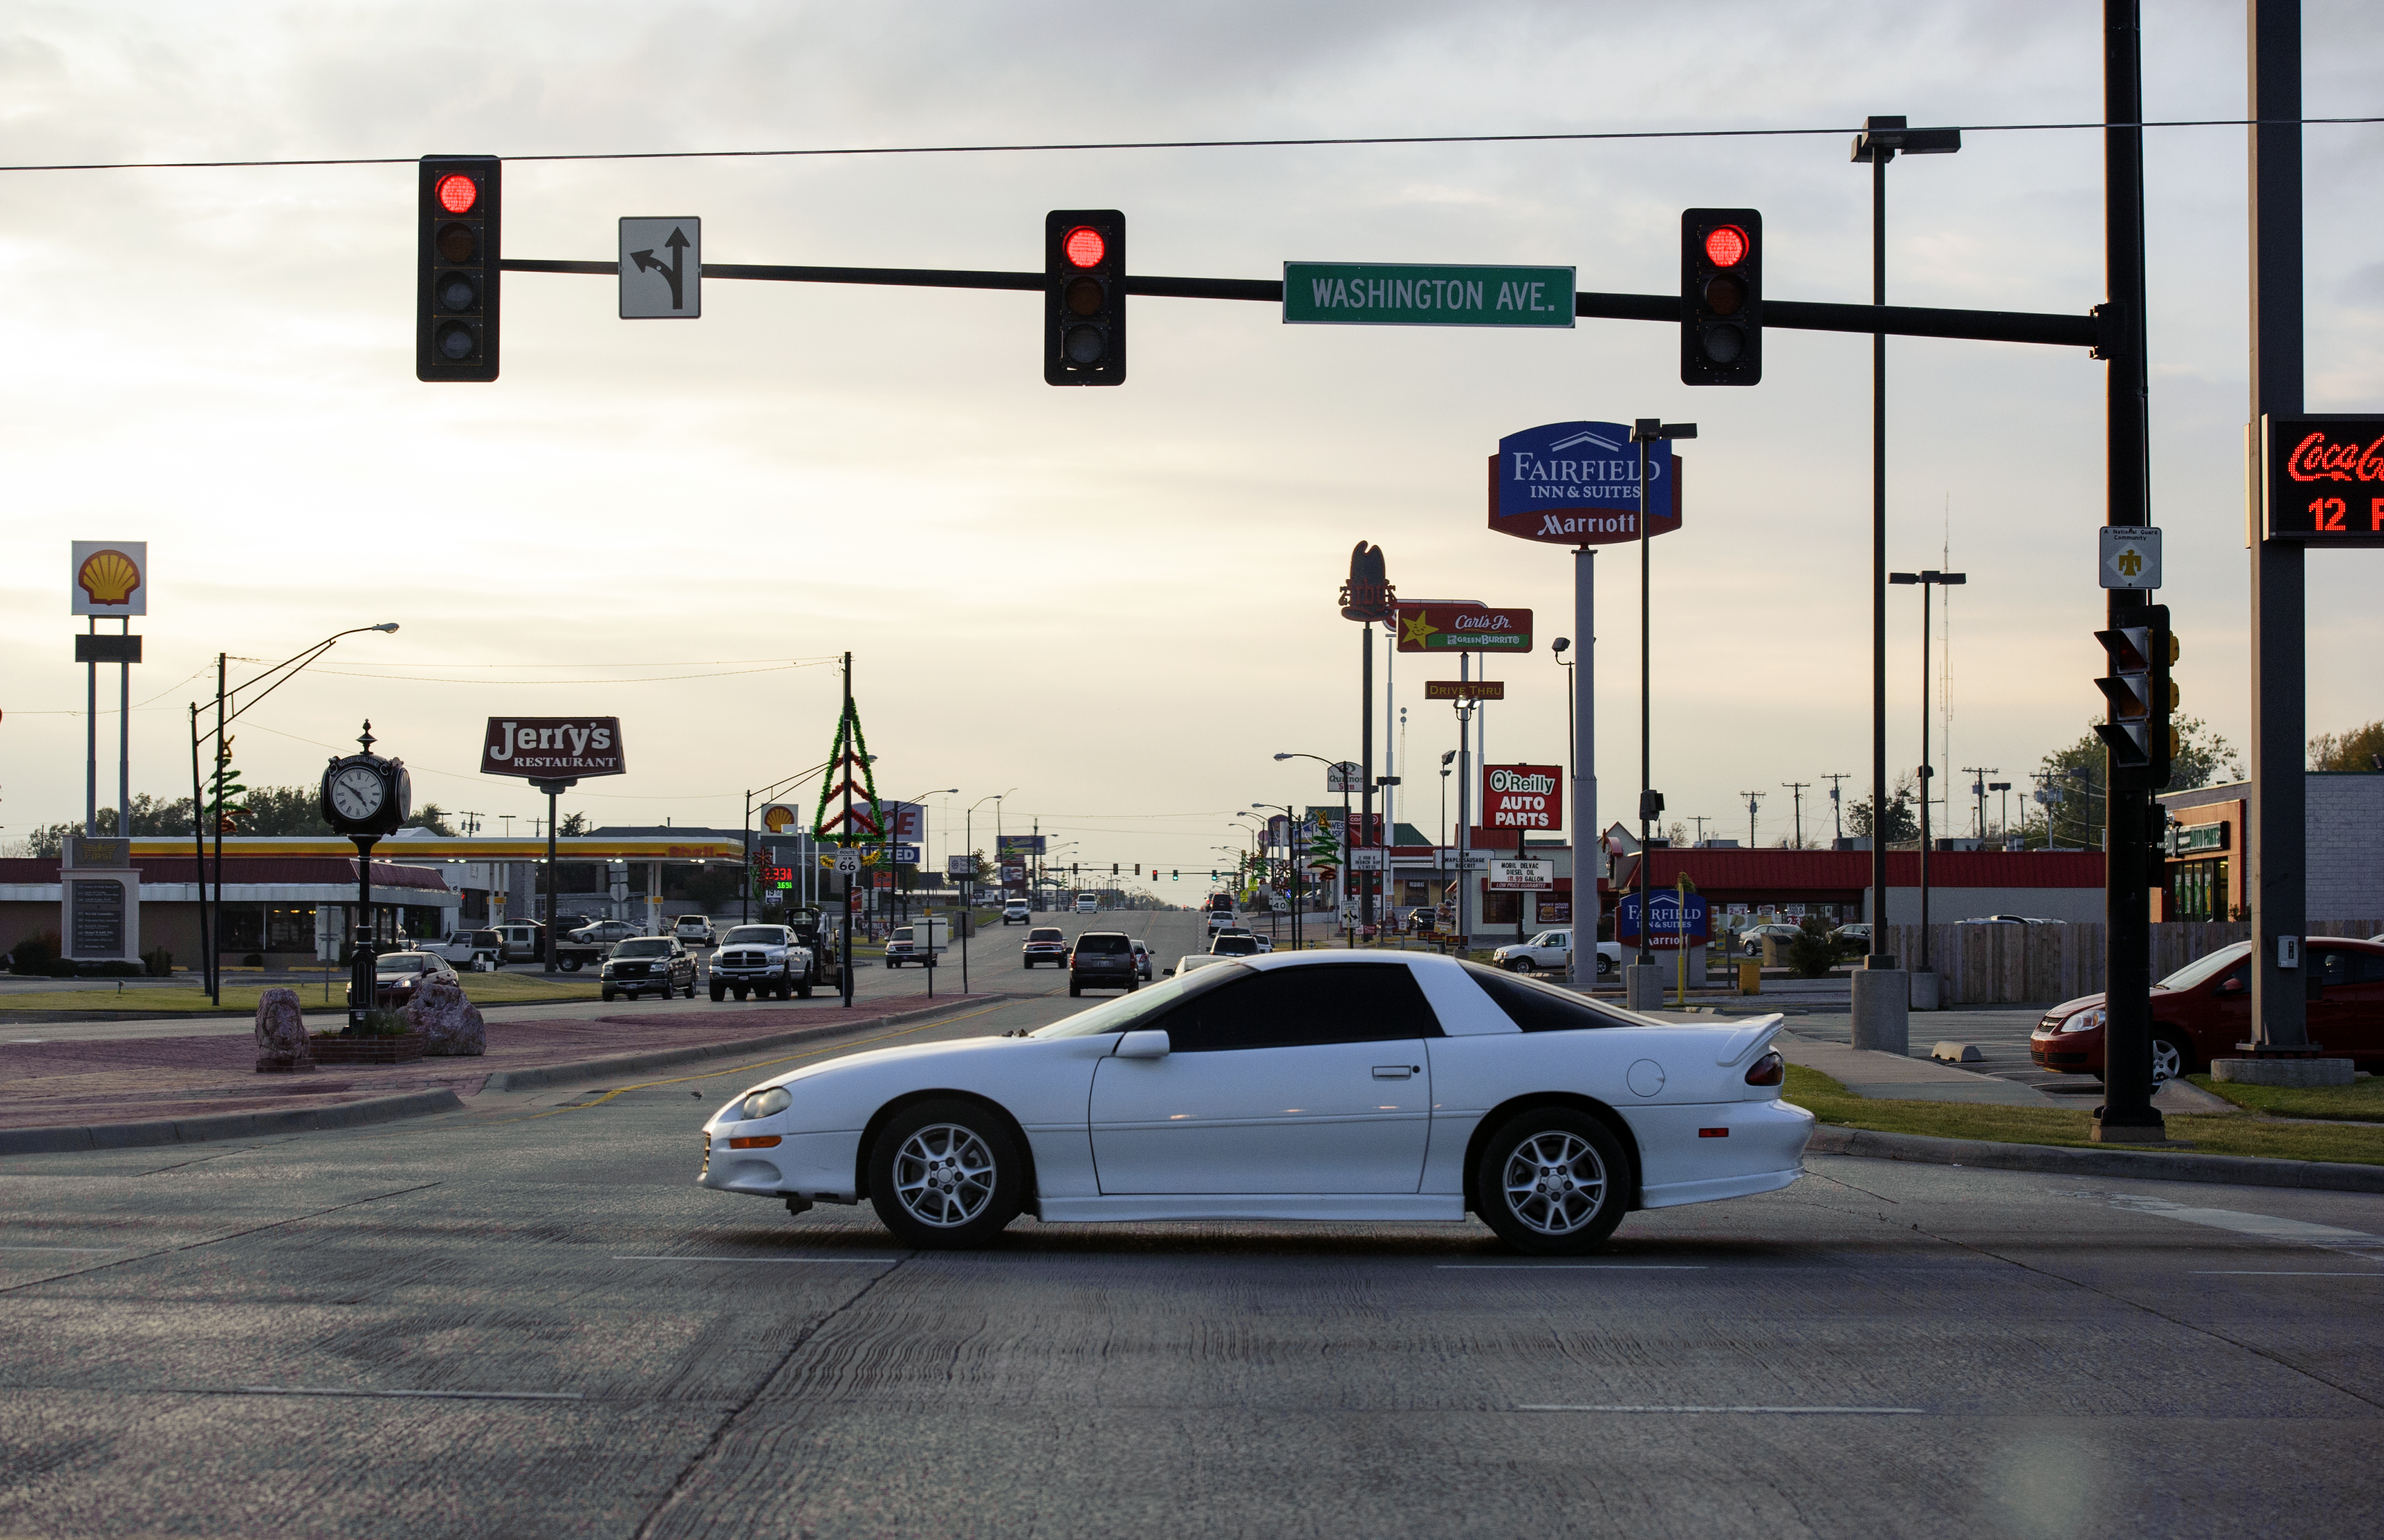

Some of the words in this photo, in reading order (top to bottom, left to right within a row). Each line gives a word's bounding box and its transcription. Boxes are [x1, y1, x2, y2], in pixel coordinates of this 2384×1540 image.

[1313, 278, 1482, 309] WASHINGTON
[1496, 281, 1555, 311] AVE.
[2288, 432, 2359, 481] Coca
[1513, 452, 1661, 483] FAIRFIELD
[1531, 486, 1564, 498] INN
[1567, 486, 1580, 498] &
[1583, 486, 1641, 498] SUITES
[2309, 498, 2346, 530] 12
[1537, 514, 1635, 535] Marriott
[1455, 614, 1491, 630] Carl's
[1491, 614, 1512, 630] Jr.
[1430, 685, 1466, 695] DRIVE
[1470, 686, 1501, 695] THRU
[490, 722, 611, 761] Jerry's
[514, 757, 616, 767] RESTAURANT
[1490, 770, 1555, 795] O'Reilly
[1500, 796, 1545, 810] AUTO
[1495, 812, 1549, 826] PARTS
[669, 846, 713, 857] Shell
[840, 861, 856, 871] 66
